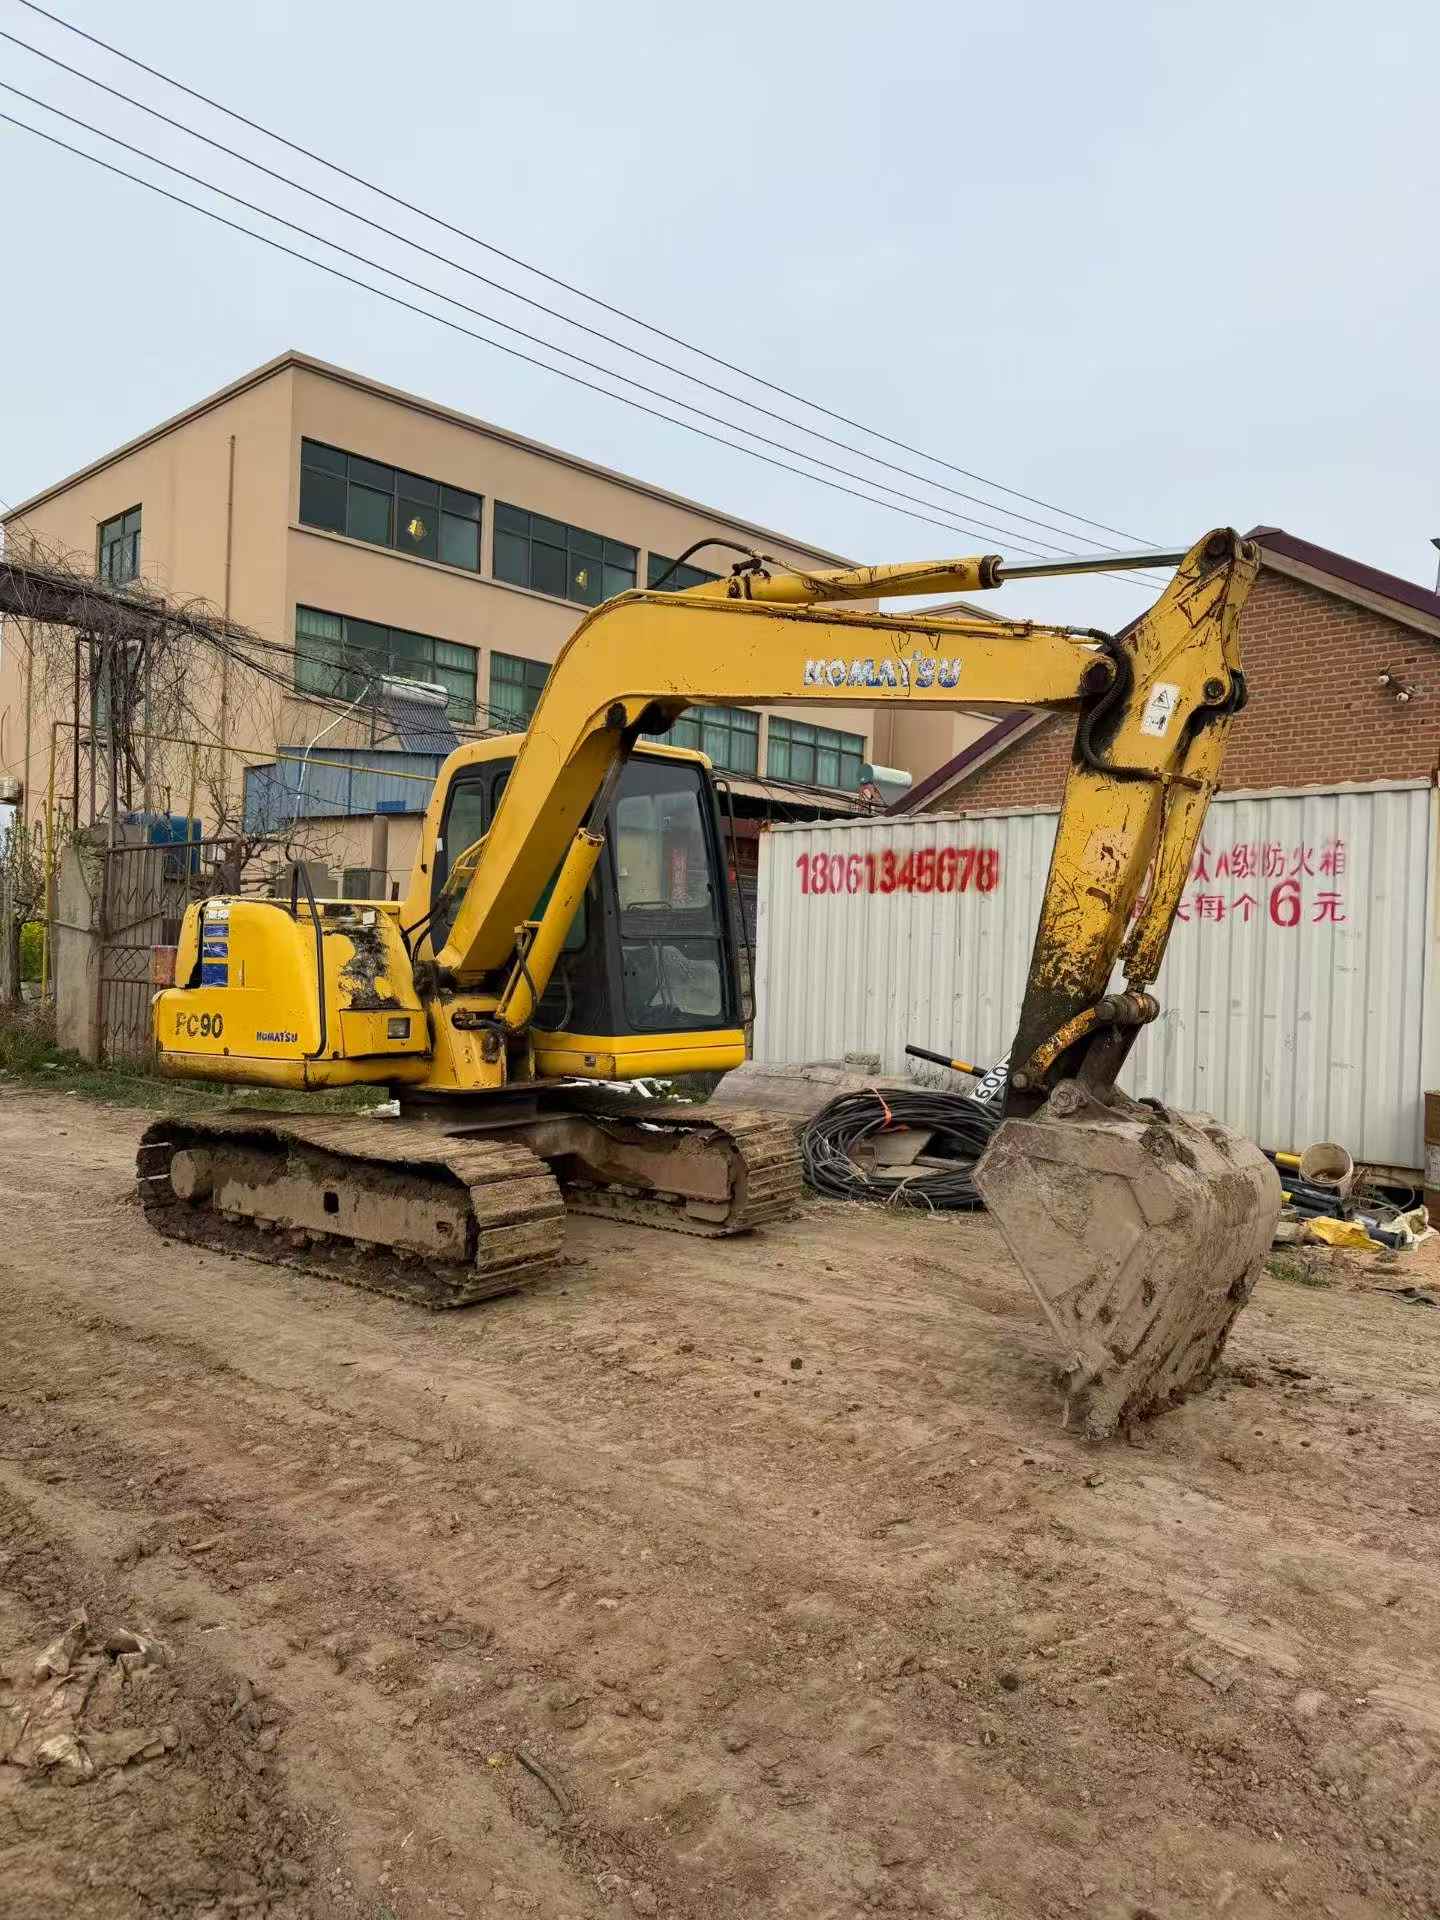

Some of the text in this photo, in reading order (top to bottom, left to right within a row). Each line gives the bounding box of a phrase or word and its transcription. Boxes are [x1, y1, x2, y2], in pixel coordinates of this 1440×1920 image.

[803, 651, 962, 688] KOMATSU
[796, 848, 998, 894] 18061345678
[175, 1010, 225, 1039] PC90
[256, 1031, 298, 1042] KOMATSU
[975, 1060, 1010, 1098] 600
